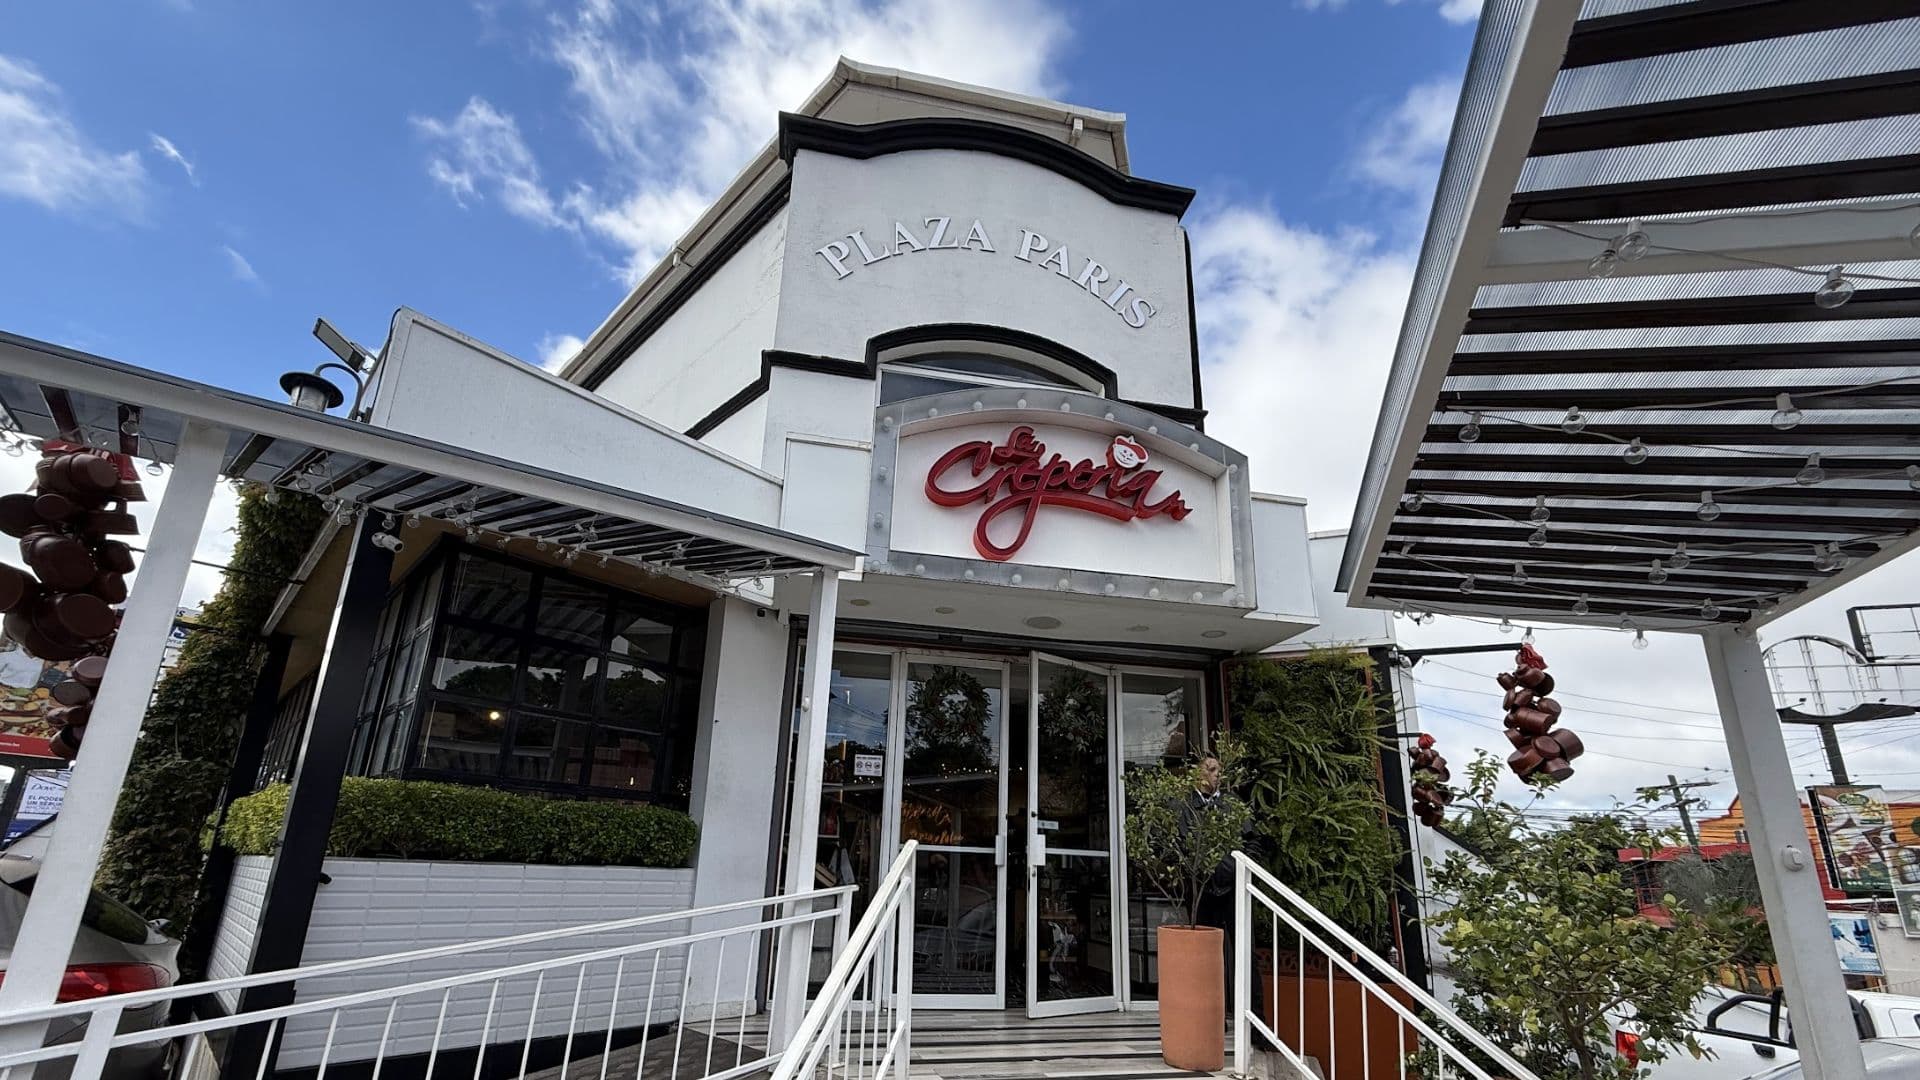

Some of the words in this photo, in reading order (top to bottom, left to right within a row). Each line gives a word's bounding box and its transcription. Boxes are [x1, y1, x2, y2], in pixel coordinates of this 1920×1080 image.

[816, 217, 996, 280] PLAZA
[1014, 229, 1157, 329] PARIS
[994, 426, 1046, 462] La
